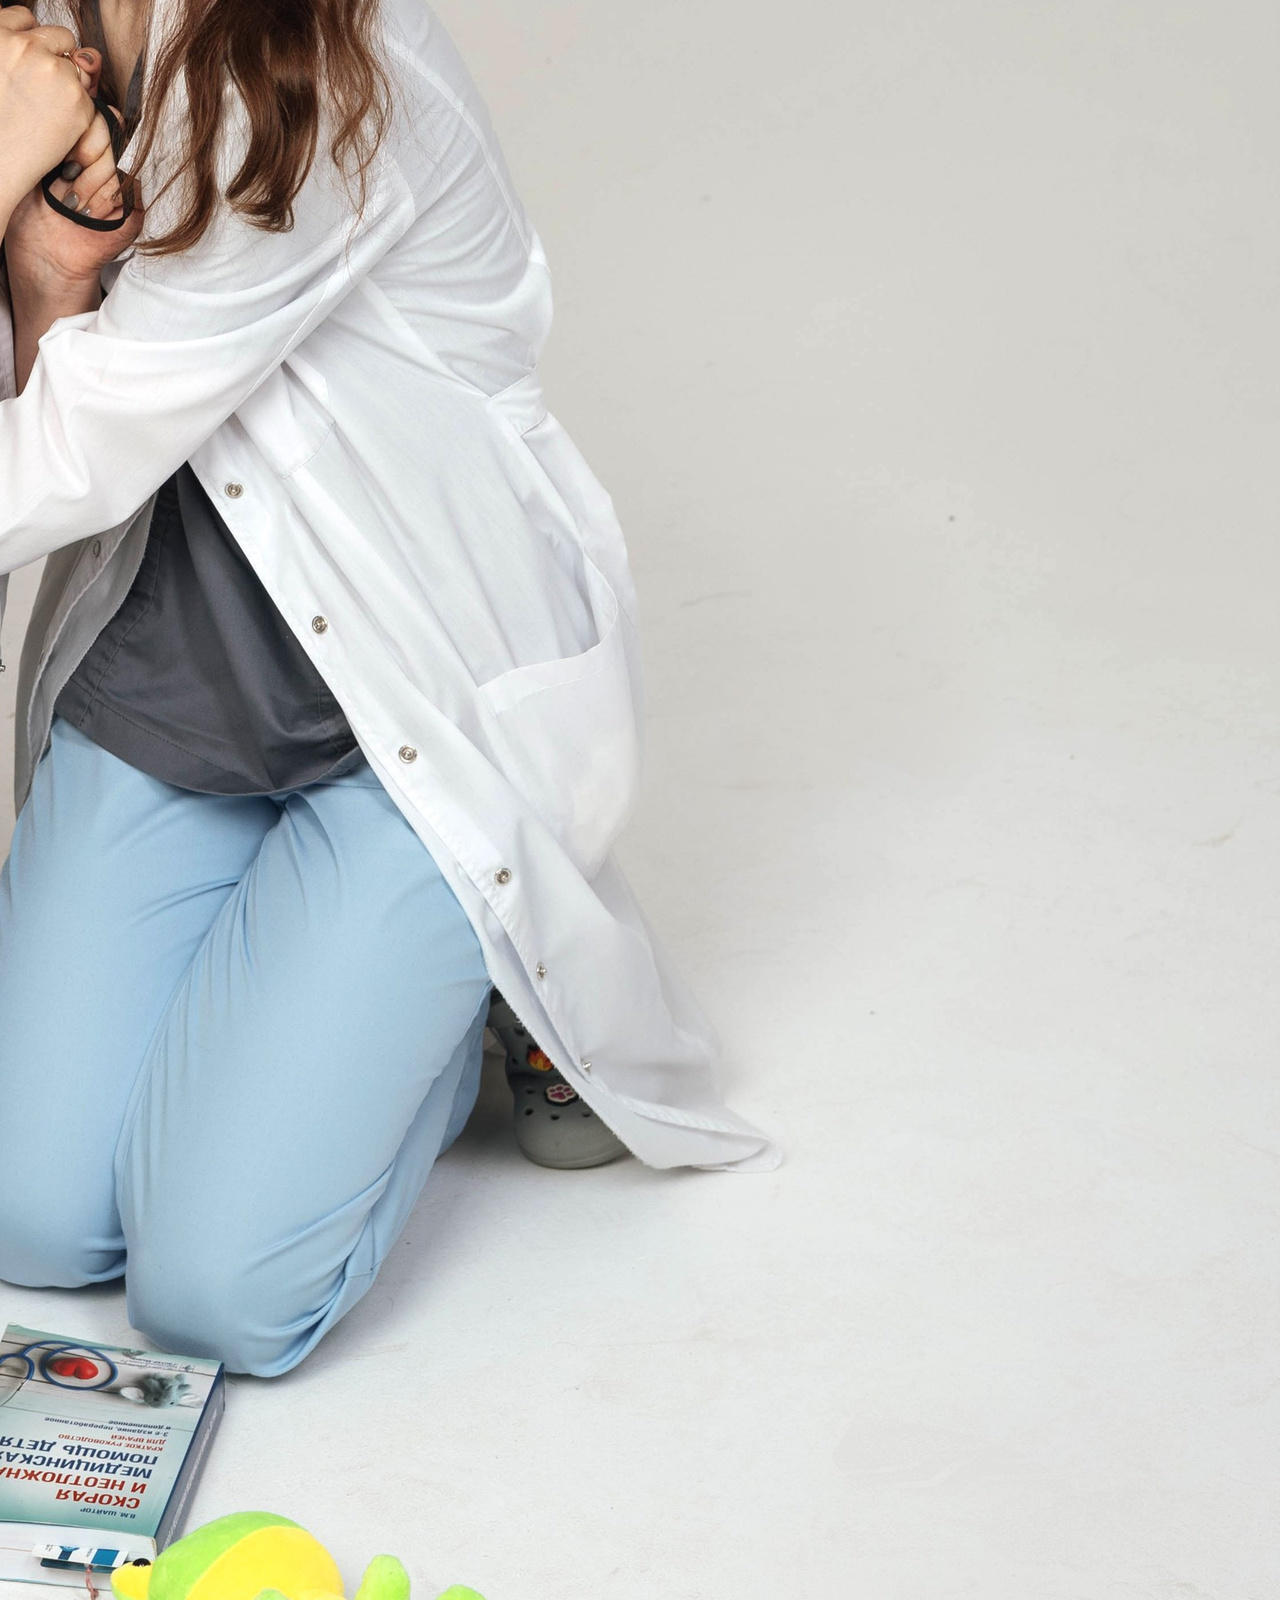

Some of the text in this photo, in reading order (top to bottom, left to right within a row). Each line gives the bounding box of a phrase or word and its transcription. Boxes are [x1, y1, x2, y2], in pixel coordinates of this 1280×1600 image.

[44, 1417, 114, 1430] переработанное
[108, 1420, 164, 1430] дополненное
[116, 1426, 153, 1435] издание,
[58, 1434, 164, 1452] КРАТКОЕ РУКОВОДСТВО
[111, 1434, 145, 1443] ВРАЧЕЙ
[62, 1445, 159, 1466] ПОМОЩЬ
[131, 1482, 147, 1494] И
[56, 1489, 140, 1510] СКОРАЯ
[80, 1508, 117, 1516] ШАЙТОР
